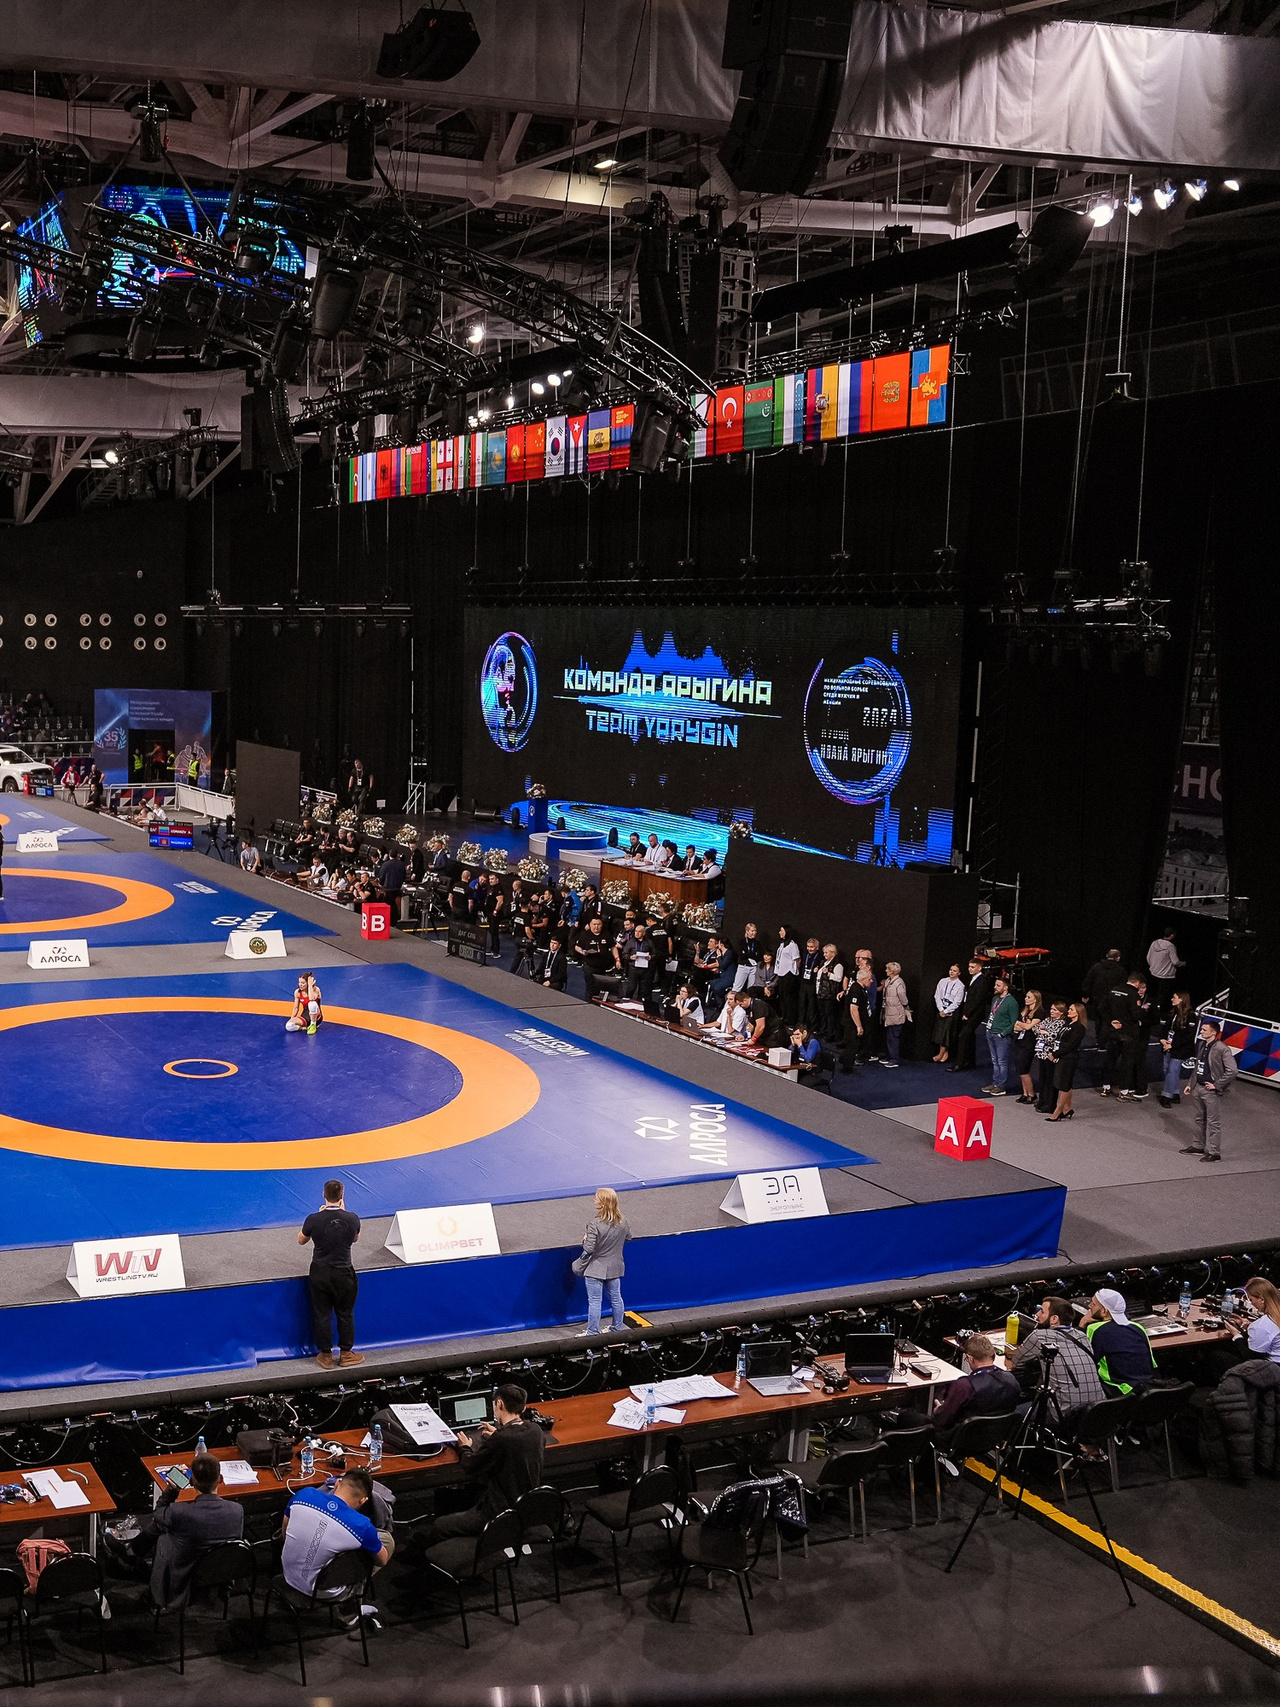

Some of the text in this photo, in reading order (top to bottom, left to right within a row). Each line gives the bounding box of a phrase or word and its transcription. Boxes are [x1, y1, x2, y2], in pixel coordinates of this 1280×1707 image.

[564, 669, 772, 705] КОМАНДА ЯРЫГИНА
[586, 710, 638, 735] TEAM
[863, 706, 897, 727] 2024
[104, 731, 118, 741] 35
[820, 743, 893, 766] ИВАНА ЯРЫГИНА
[362, 913, 367, 930] B
[371, 915, 385, 931] B
[939, 1116, 959, 1146] A
[966, 1120, 987, 1147] A
[418, 1237, 483, 1252] OLIMPBET
[94, 1248, 162, 1276] WTV
[96, 1273, 158, 1282] WRESTLINGTV.RU
